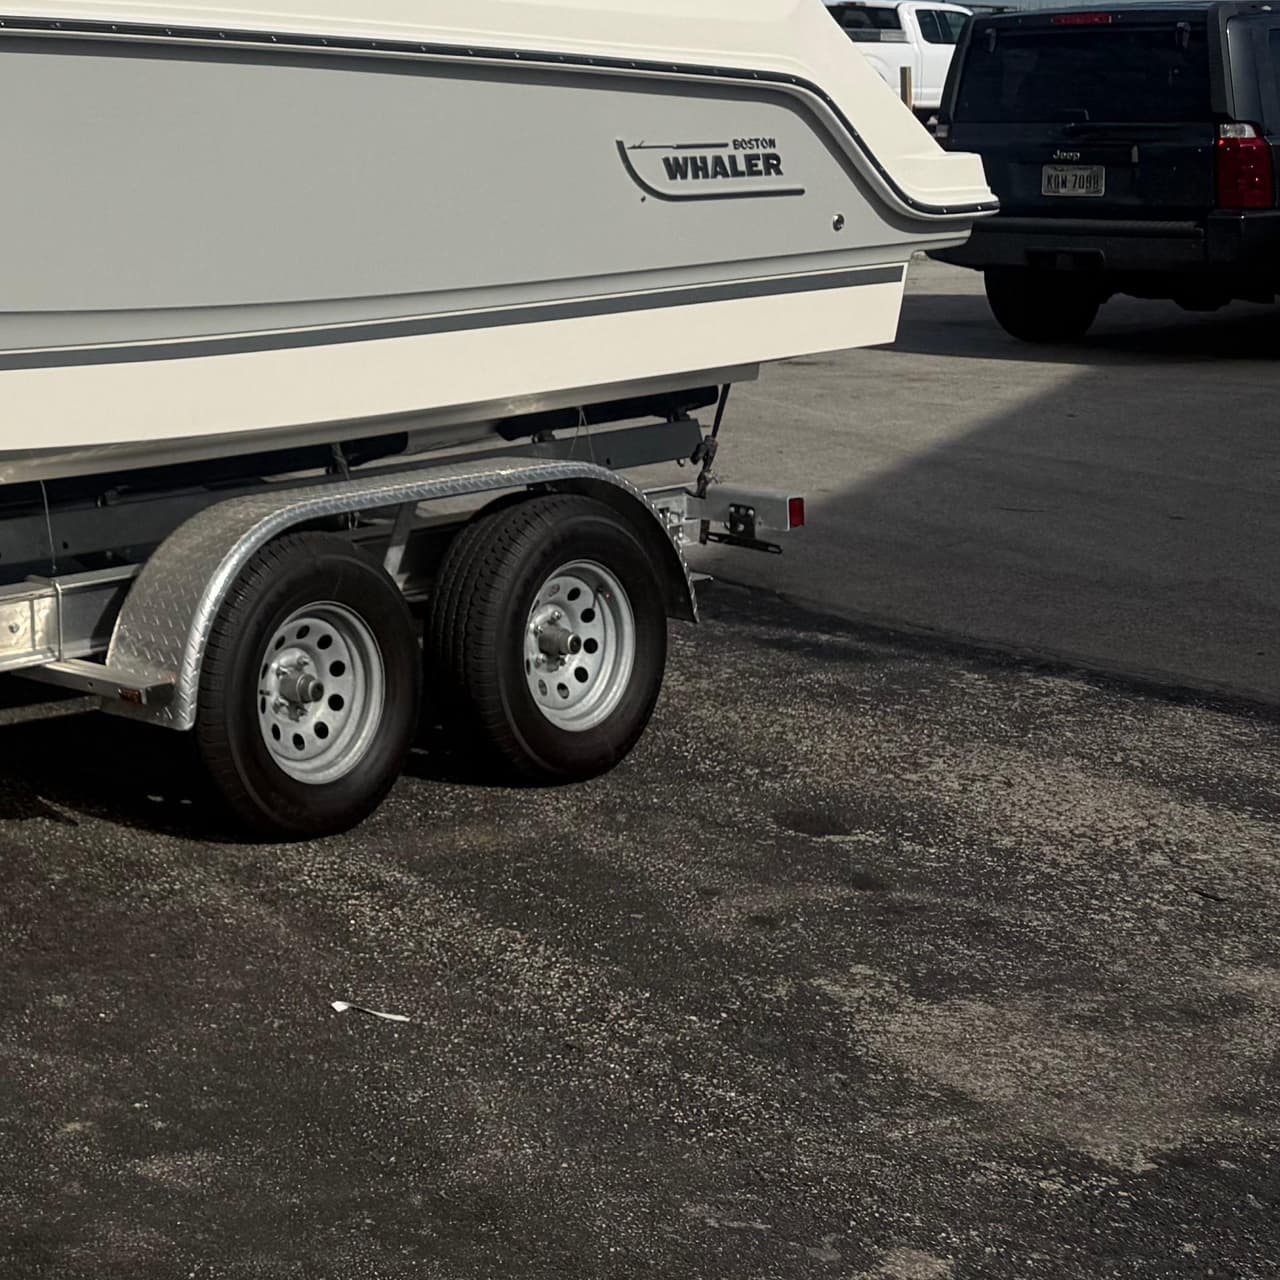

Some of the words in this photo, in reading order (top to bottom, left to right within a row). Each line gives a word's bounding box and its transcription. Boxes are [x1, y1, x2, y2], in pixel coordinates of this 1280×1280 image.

[732, 138, 776, 150] BOSTON
[1052, 149, 1080, 160] Jeep
[662, 152, 783, 181] WHALER
